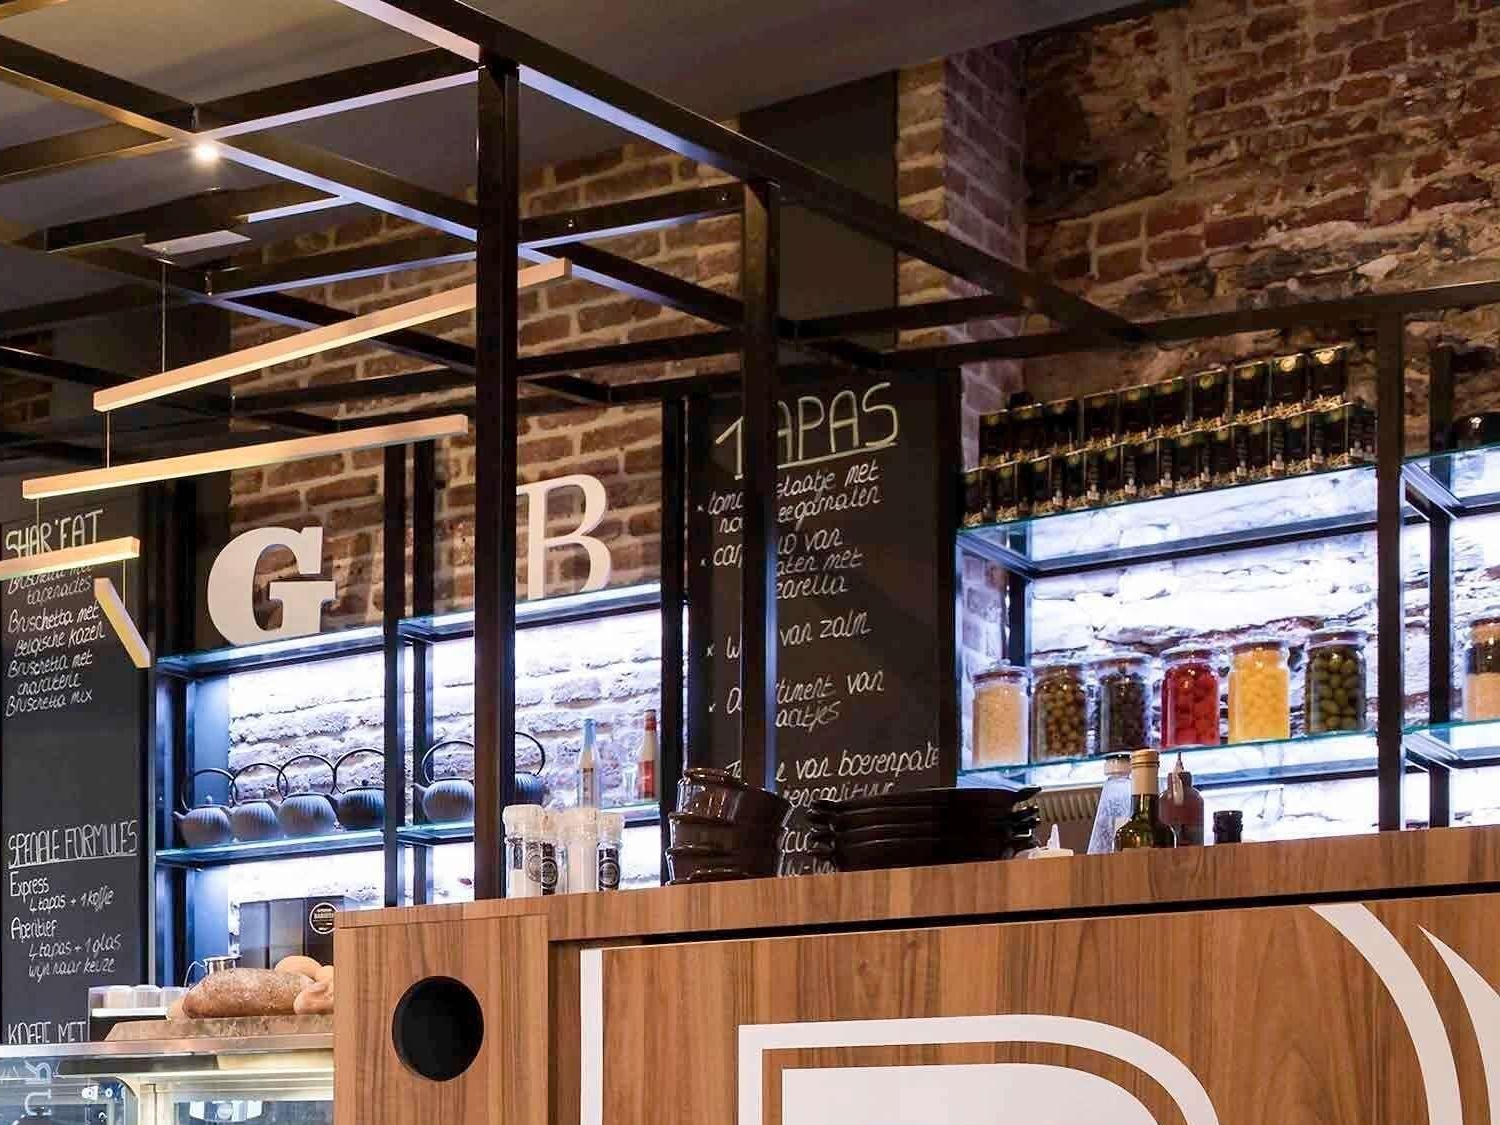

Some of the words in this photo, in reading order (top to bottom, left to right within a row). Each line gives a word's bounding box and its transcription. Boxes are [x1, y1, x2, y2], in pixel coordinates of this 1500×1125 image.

[845, 459, 880, 487] met
[804, 527, 844, 553] van
[207, 526, 337, 647] G
[516, 474, 611, 601] B
[7, 608, 74, 633] Bruschetta
[10, 871, 49, 903] Express
